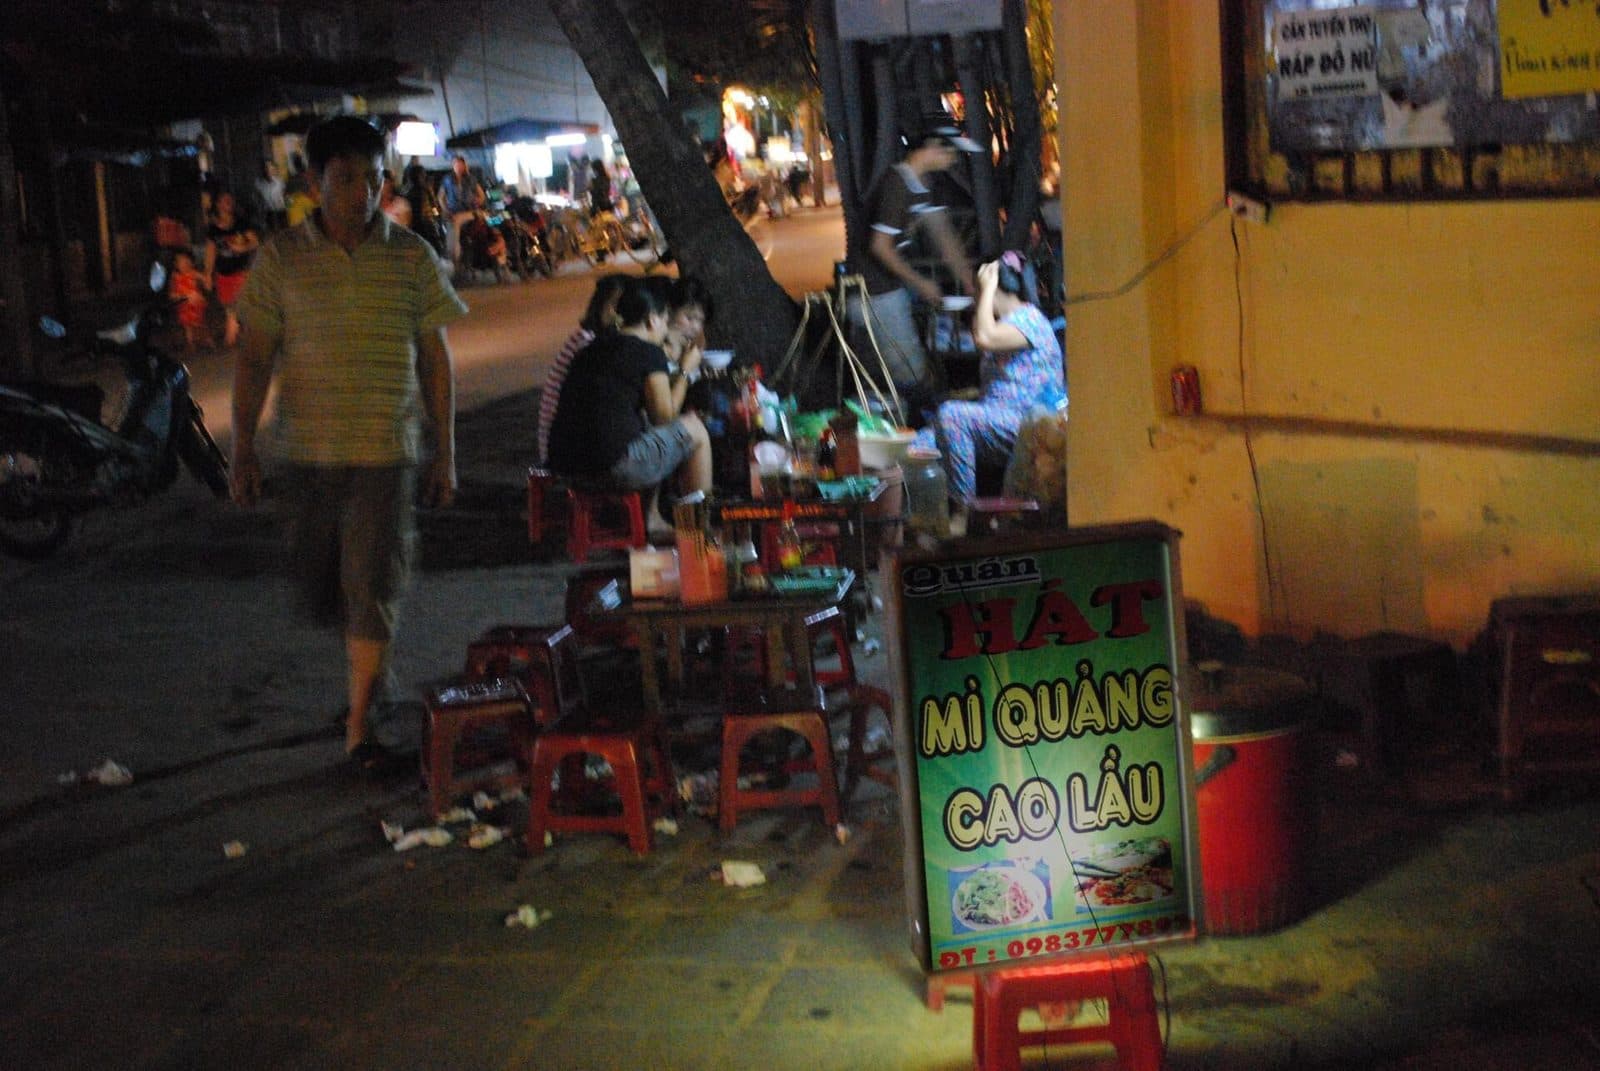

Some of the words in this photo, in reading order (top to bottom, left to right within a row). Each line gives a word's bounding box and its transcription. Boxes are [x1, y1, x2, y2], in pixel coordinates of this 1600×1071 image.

[903, 557, 1041, 597] Quán
[937, 577, 1163, 661] HÁT
[993, 658, 1176, 748] QUẢNG
[943, 777, 1061, 852] CAO
